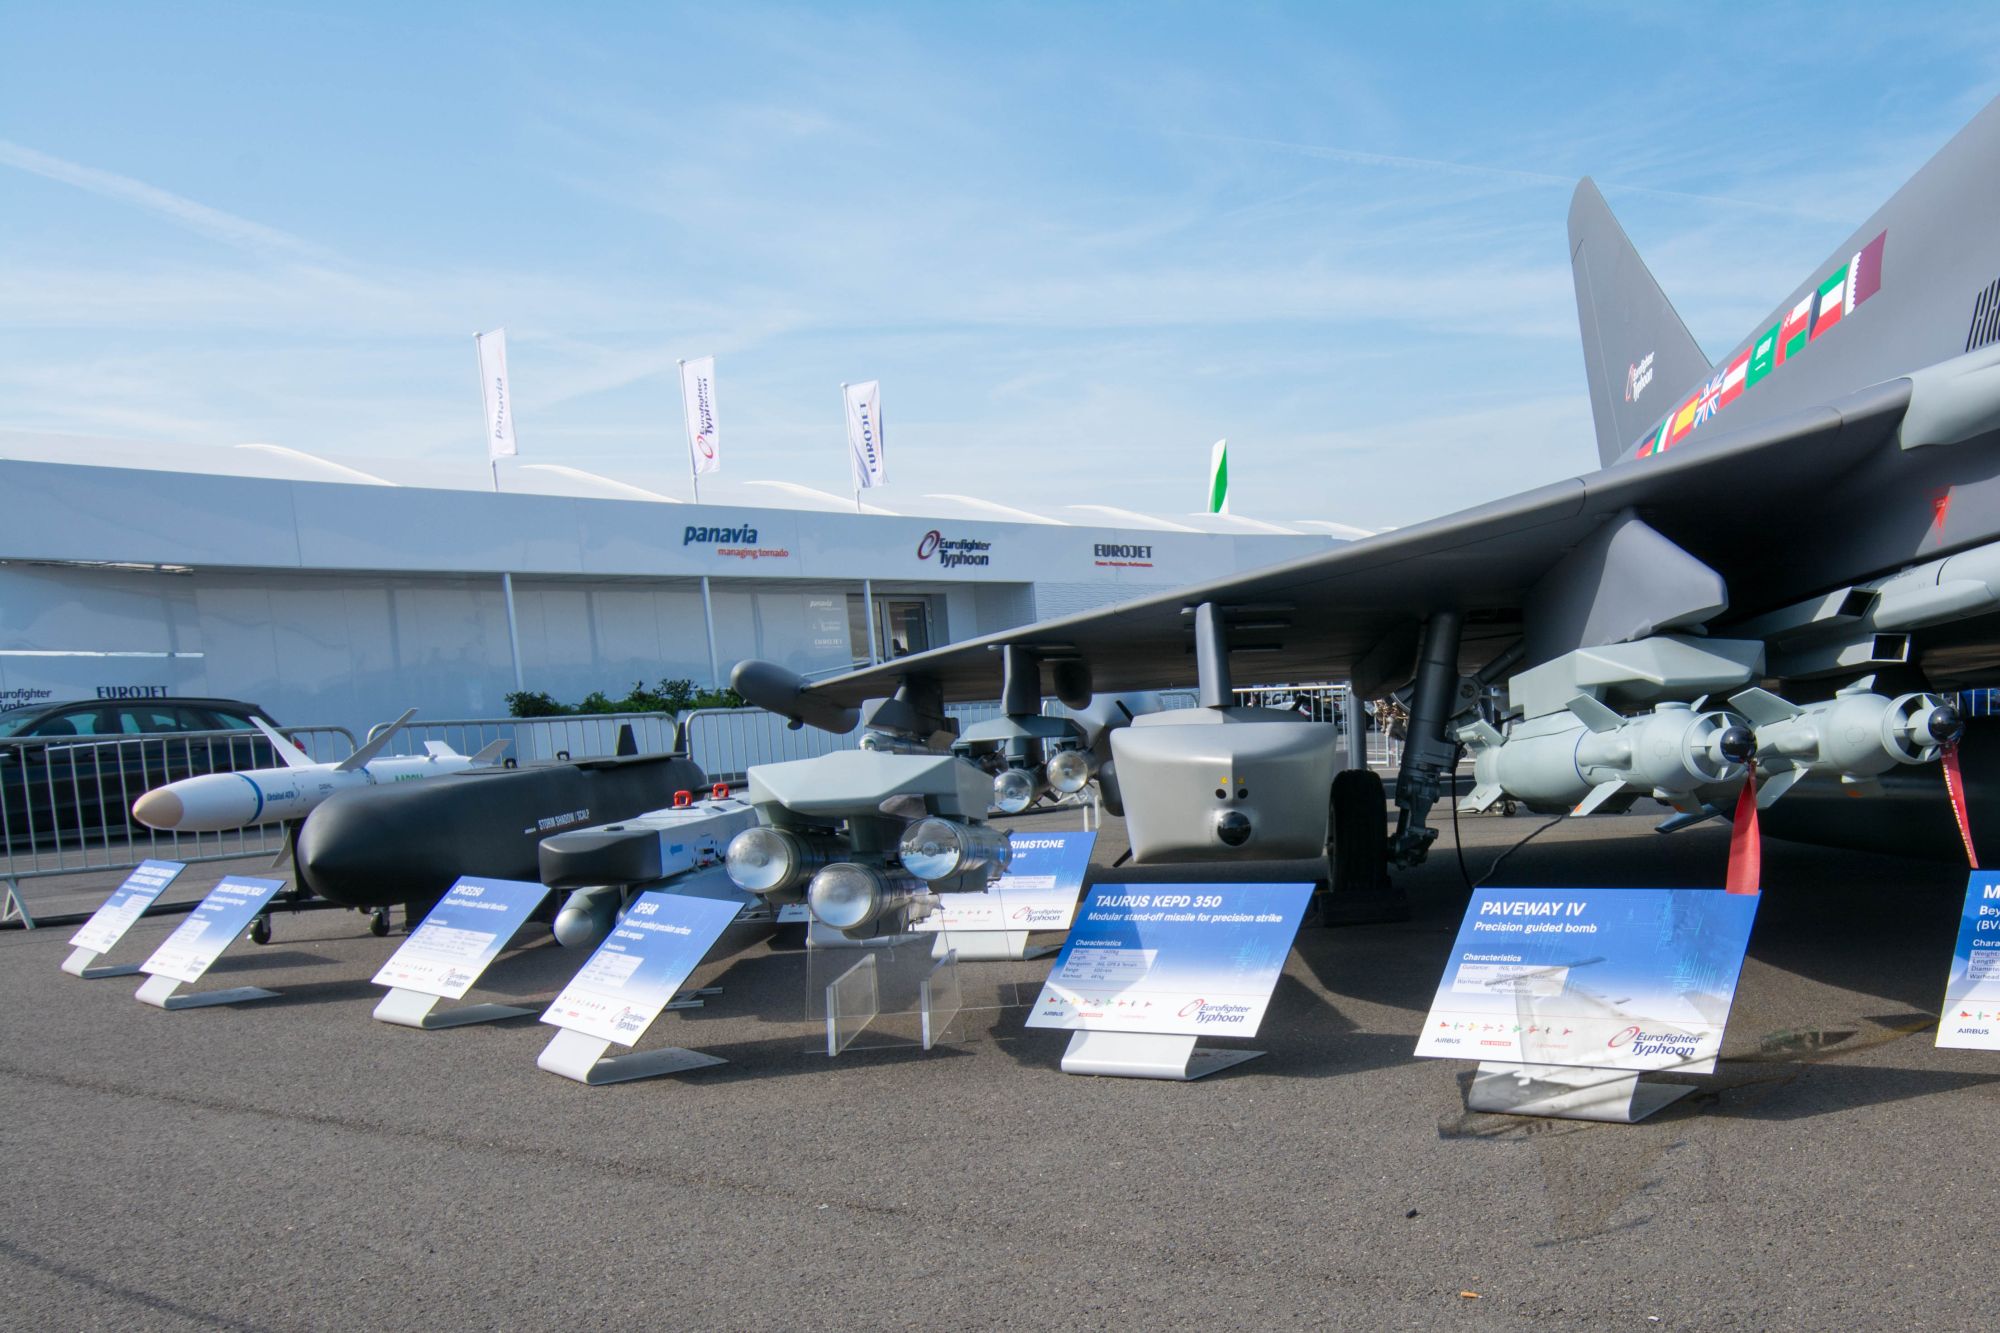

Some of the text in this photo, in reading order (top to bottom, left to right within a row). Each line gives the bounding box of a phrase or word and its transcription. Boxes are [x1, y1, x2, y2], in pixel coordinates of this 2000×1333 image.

[1633, 351, 1655, 382] Eurofighter
[1633, 367, 1653, 402] Typhoon
[495, 377, 504, 440] panavia
[697, 376, 705, 435] Eurofighter
[703, 378, 714, 435] Typhoon
[860, 403, 877, 472] EUROJET
[683, 523, 758, 546] panavia
[940, 537, 992, 553] Eurofighter
[1094, 543, 1153, 559] EUROJET
[717, 548, 789, 560] managing tornado
[939, 549, 989, 568] Typhoon
[0, 688, 52, 701] urofighter
[96, 685, 168, 699] EUROJET
[1010, 839, 1065, 849] RIMSTONE
[1983, 885, 2000, 899] M
[1095, 895, 1223, 908] TAURUS KEPD 350
[634, 902, 659, 915] SPEAR
[1480, 902, 1587, 916] PAVEWAY IV
[1979, 905, 2000, 918] Bey
[1025, 914, 1061, 923] Typhoon
[1087, 912, 1282, 923] Modular stand-off missile for precision strike
[1474, 922, 1598, 934] Precision guided bomb
[1976, 920, 2000, 932] (BV
[1075, 939, 1121, 947] Characteristics
[1972, 939, 2000, 947] Chara
[1463, 953, 1521, 962] Characteristics
[1201, 1003, 1251, 1013] Eurofighter
[1195, 1011, 1244, 1023] Typhoon
[1636, 1031, 1704, 1044] Eurofighter
[1957, 1027, 1989, 1035] AIRBUS
[1631, 1041, 1696, 1056] Typhoon
